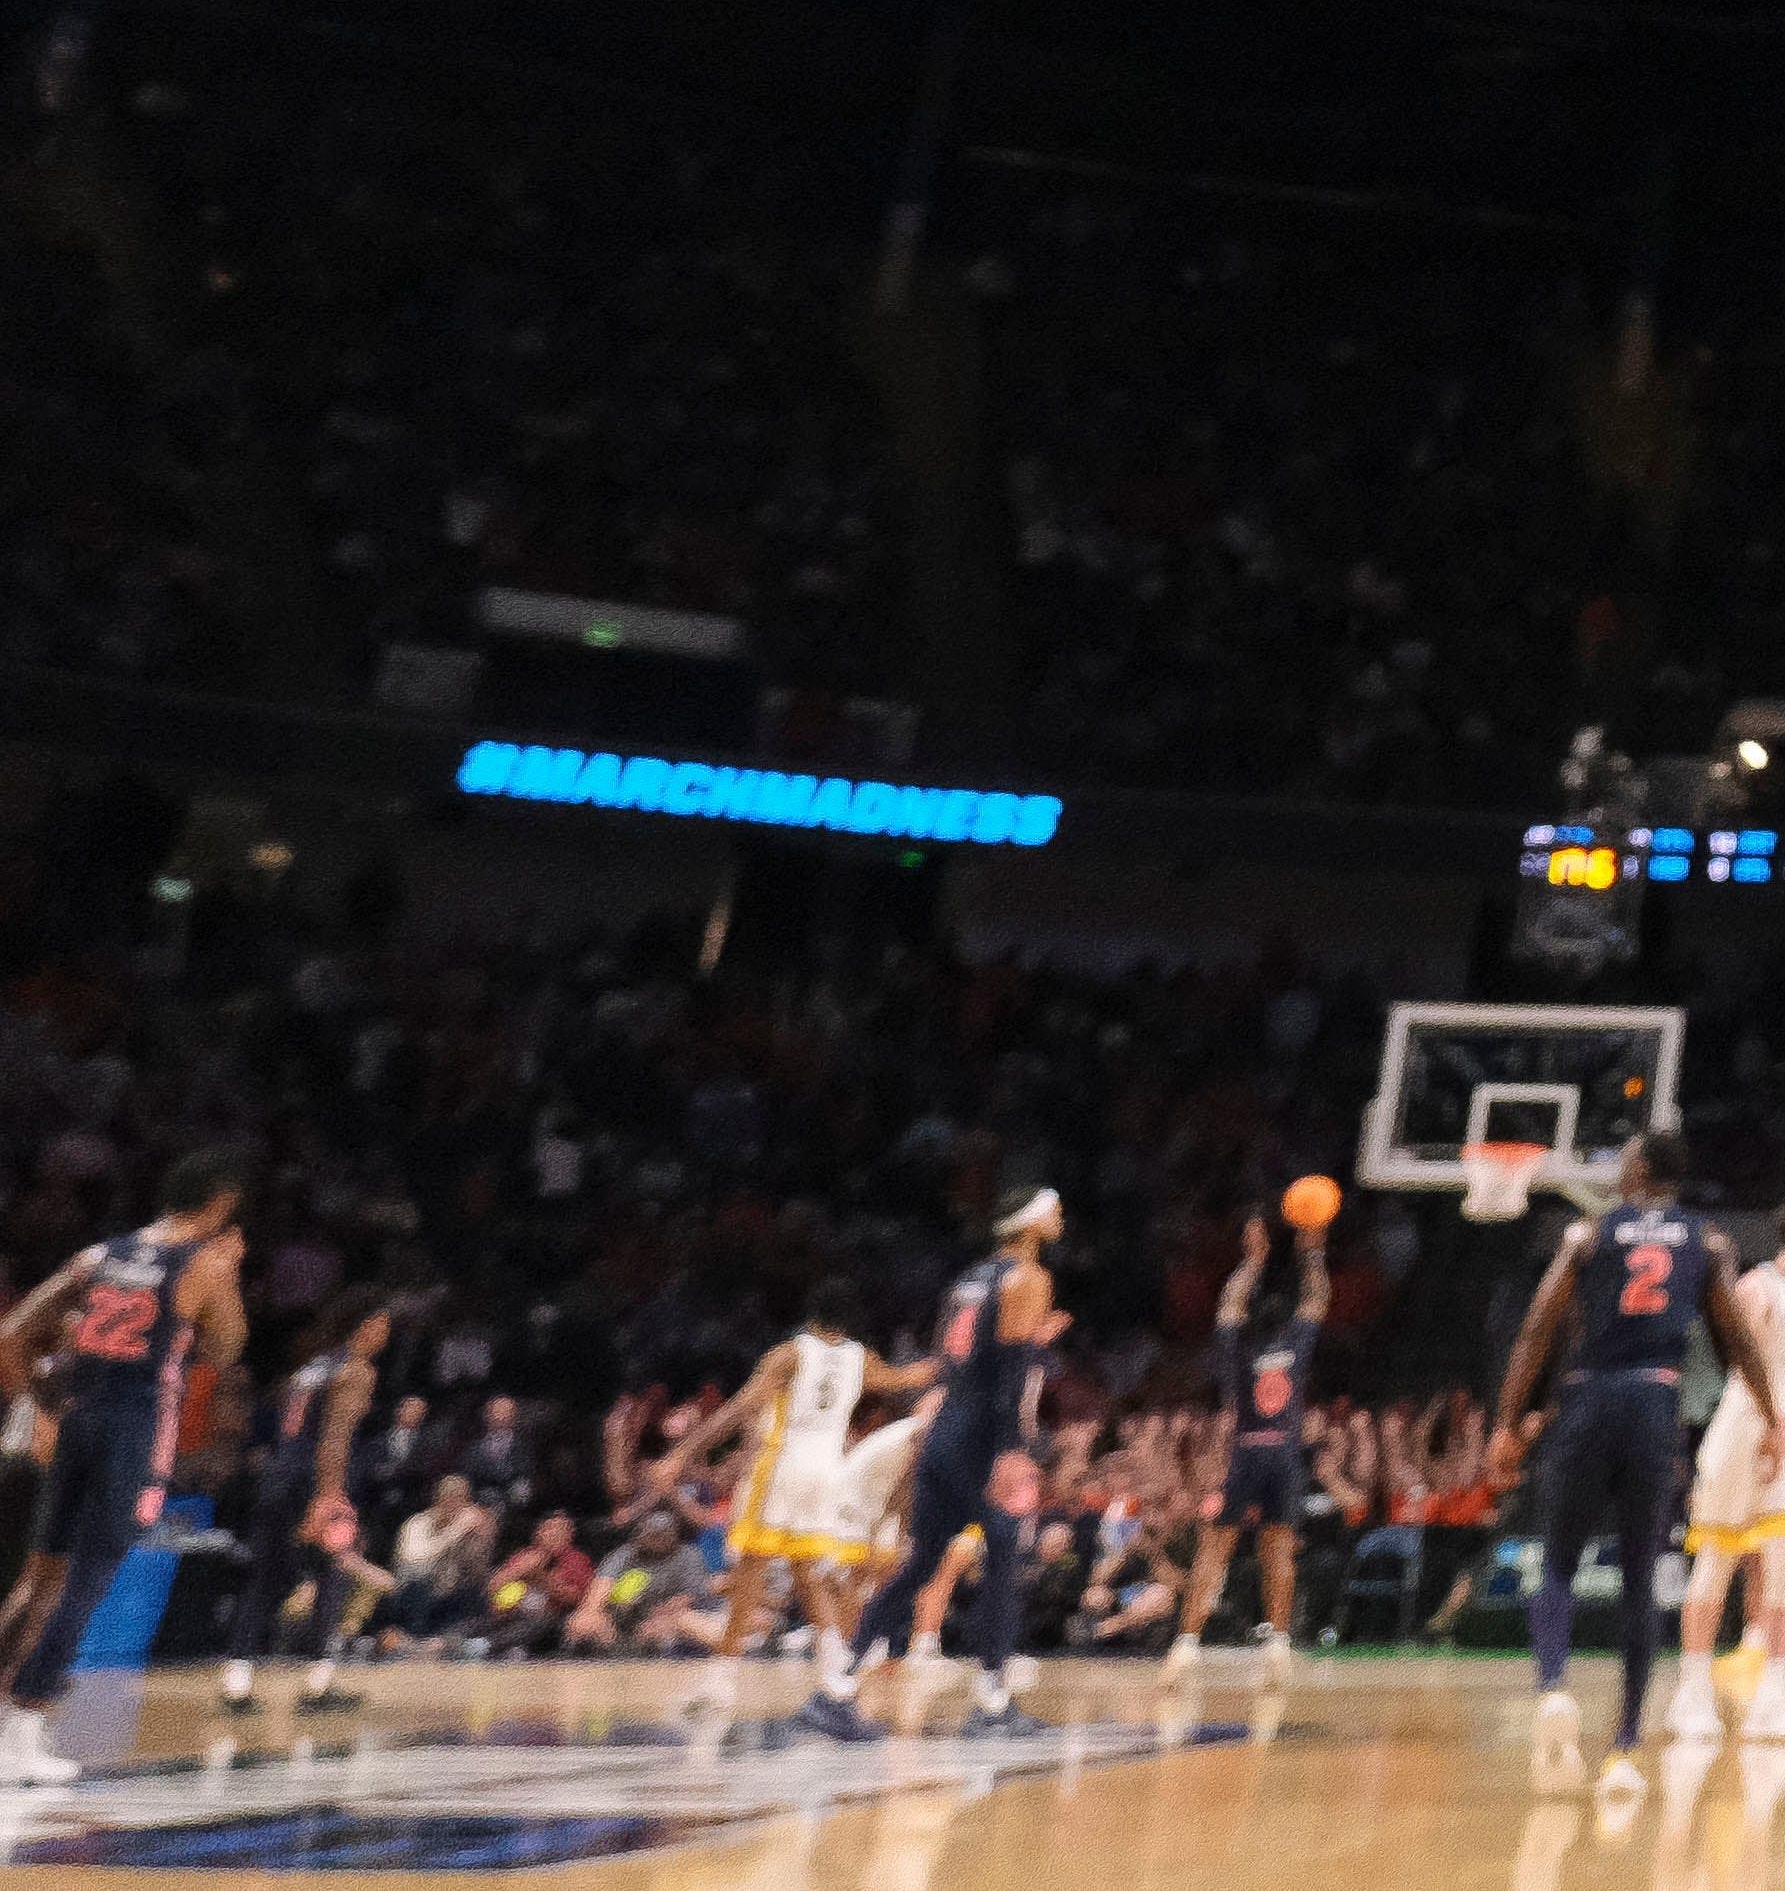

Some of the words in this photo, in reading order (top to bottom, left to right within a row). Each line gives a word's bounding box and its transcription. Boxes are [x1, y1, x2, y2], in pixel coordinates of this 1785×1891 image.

[457, 740, 1063, 847] #MARCHMADNESS
[1619, 1244, 1674, 1315] 2
[76, 1284, 159, 1360] 22
